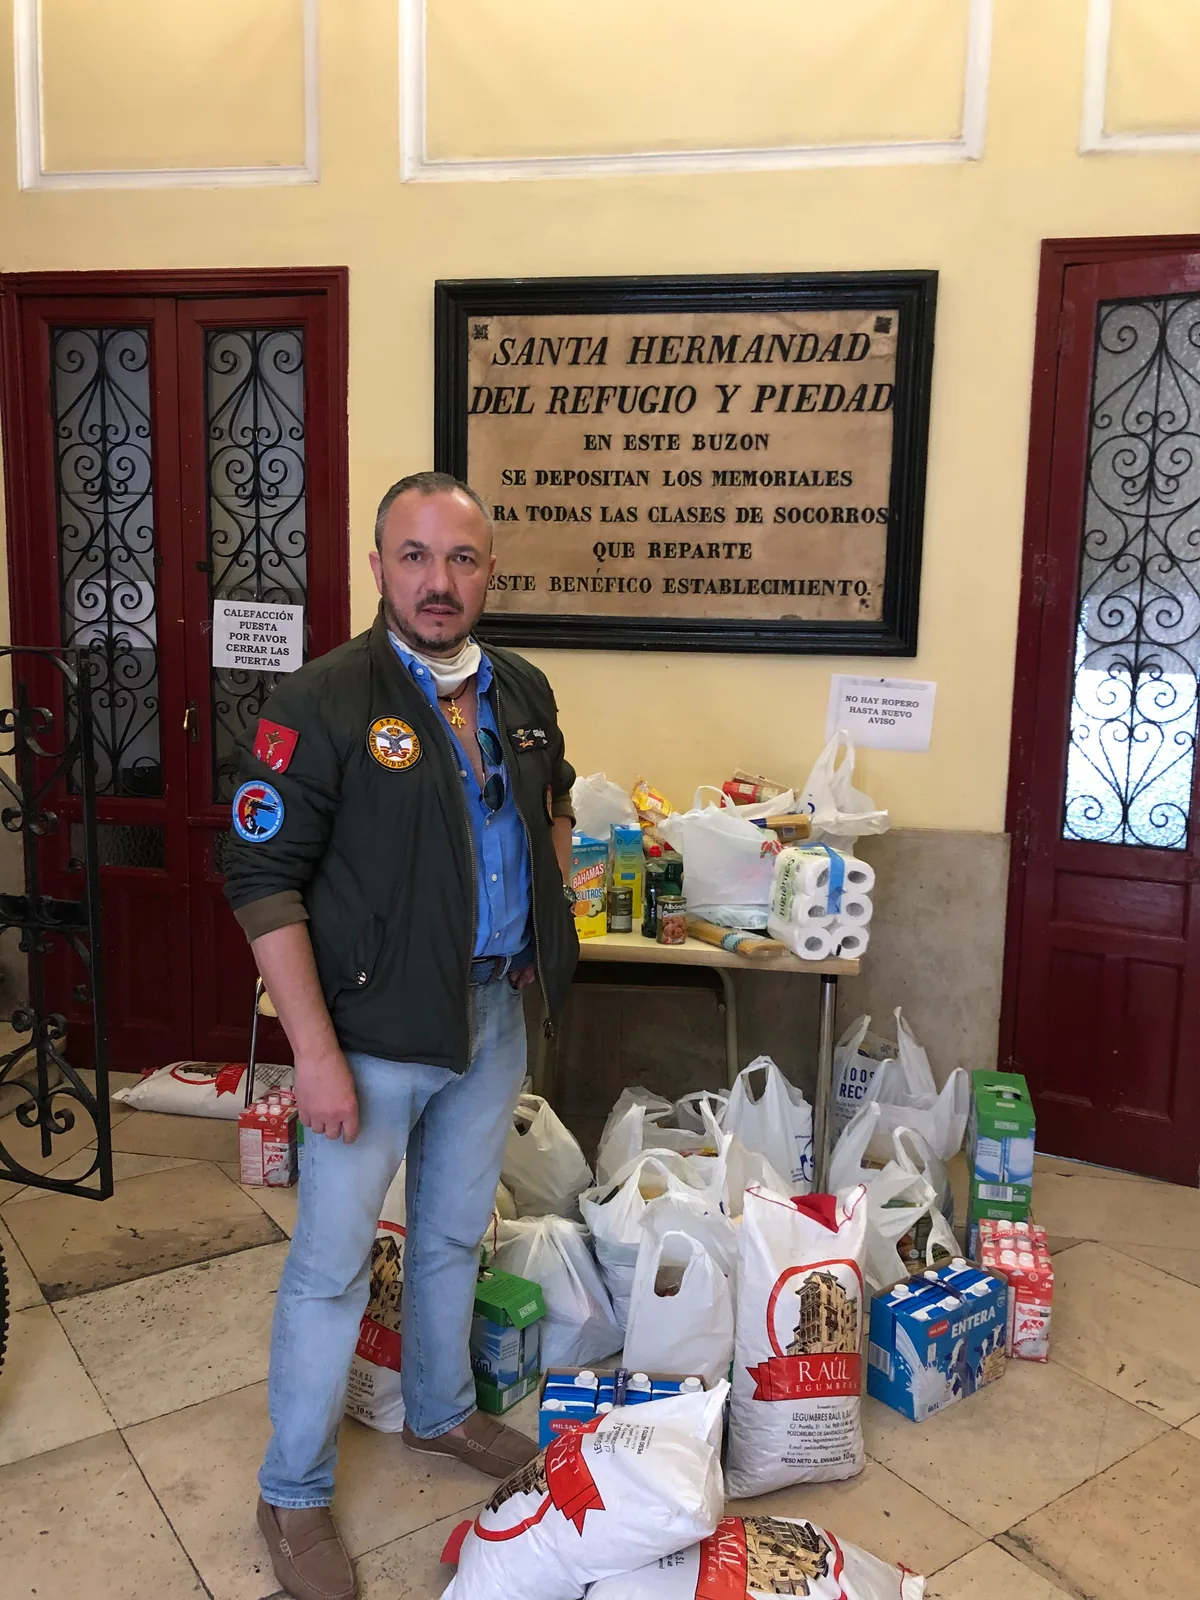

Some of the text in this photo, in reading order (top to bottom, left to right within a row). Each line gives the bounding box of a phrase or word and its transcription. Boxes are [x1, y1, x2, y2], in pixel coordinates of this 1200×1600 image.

[492, 332, 872, 366] SANTA HERMANDAD
[467, 383, 894, 415] DEL REFUGIO Y PIEDAD
[584, 433, 770, 451] EN ESTE BUZON
[501, 469, 853, 487] SE DEPOSITAN LOS MEMORIALES
[493, 505, 888, 524] RA TODAS LAS CLASES DE SOCORROS
[593, 542, 752, 560] QUE REPARTE
[662, 578, 871, 596] ESTABLECIMIENTO.
[223, 608, 294, 620] CALEFACCIÓN
[239, 621, 278, 631] PUESTA
[229, 632, 287, 644] POR FAVOR
[226, 644, 290, 655] CERRAR LAS
[234, 656, 281, 666] PUERTAS
[860, 696, 879, 705] HAY
[881, 698, 920, 708] ROPERO
[849, 706, 912, 718] HASTA NUEVO
[379, 719, 406, 729] REAL
[867, 717, 896, 726] AVISO
[377, 754, 397, 767] CLUB
[572, 863, 604, 888] BAHAMAS
[581, 887, 603, 900] LITROS
[951, 1305, 996, 1338] ENTERA
[798, 1356, 851, 1383] RAÚL
[786, 1381, 858, 1394] LEGUMBRES
[792, 1412, 828, 1422] LEGUMBRES
